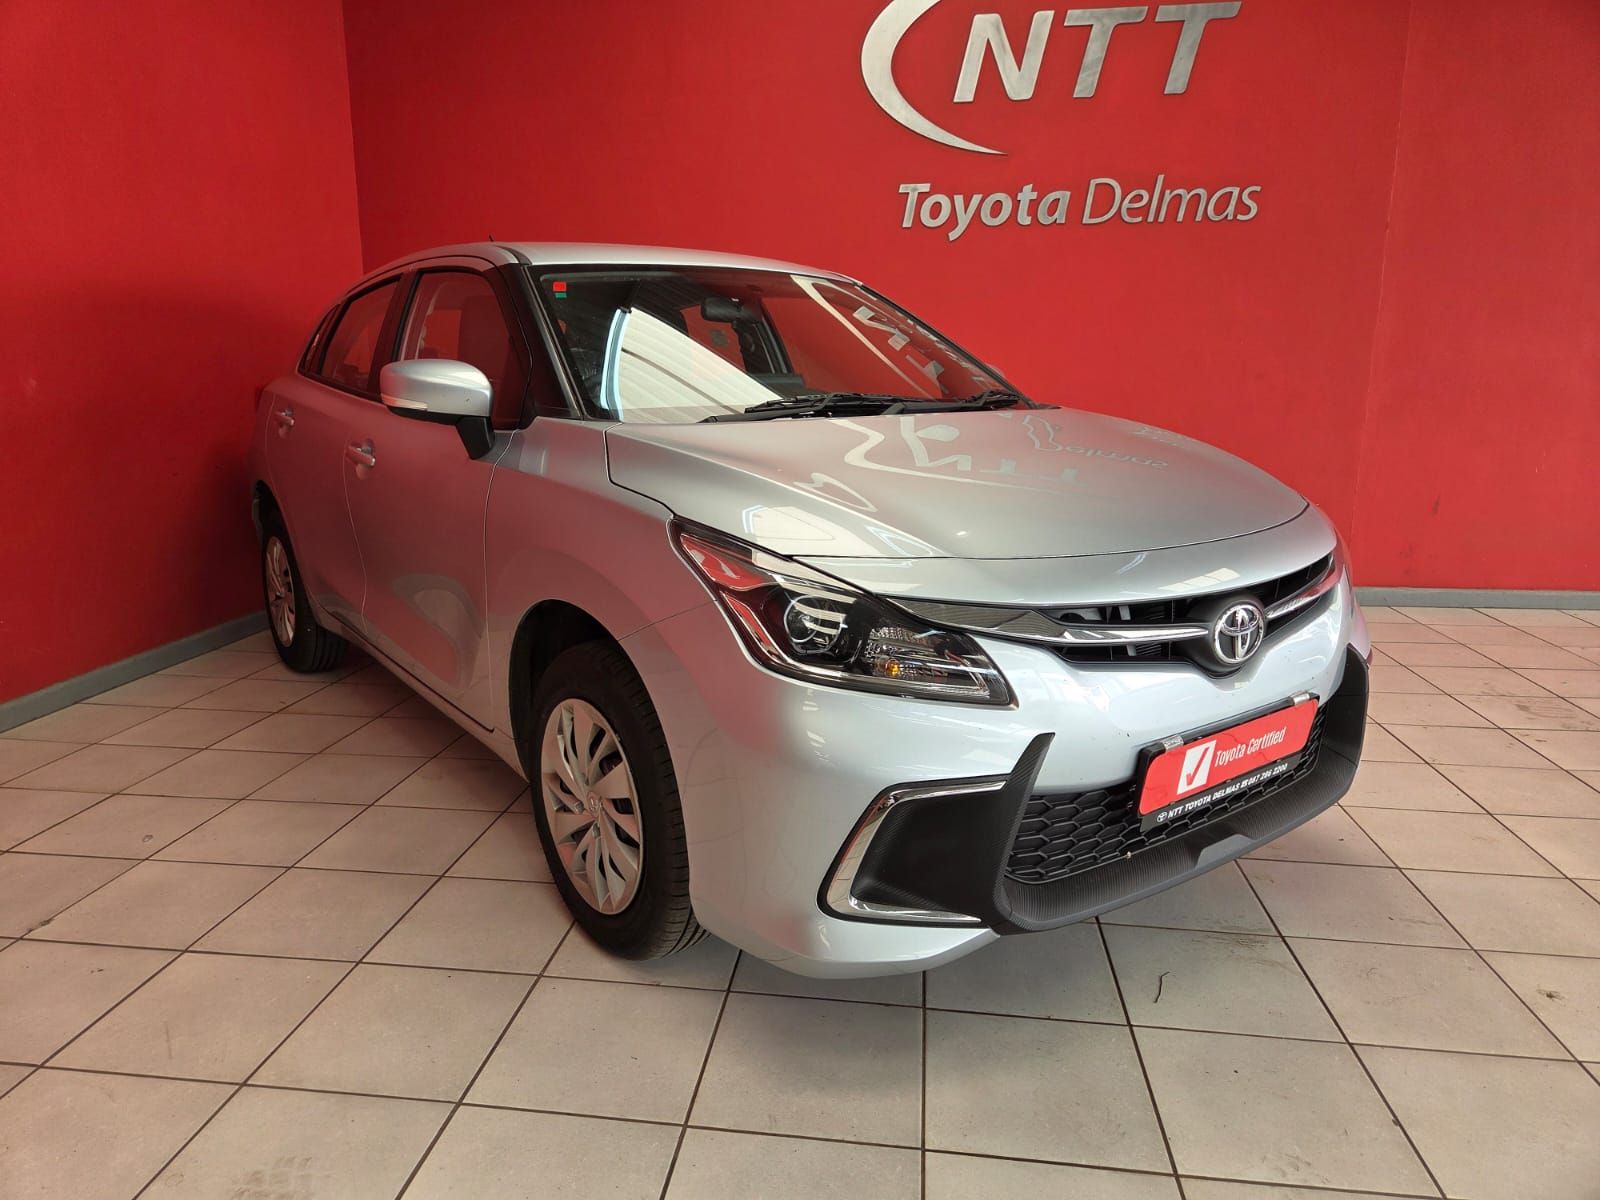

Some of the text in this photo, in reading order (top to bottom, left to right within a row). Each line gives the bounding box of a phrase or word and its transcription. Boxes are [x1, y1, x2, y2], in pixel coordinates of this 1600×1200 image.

[953, 1, 1242, 103] NTT
[898, 174, 1261, 241] Toyota Delmas
[1214, 726, 1287, 767] Toyota Certified
[1168, 805, 1184, 818] NTT
[1185, 795, 1212, 811] TOYOTA
[1212, 783, 1240, 800] DELMAS
